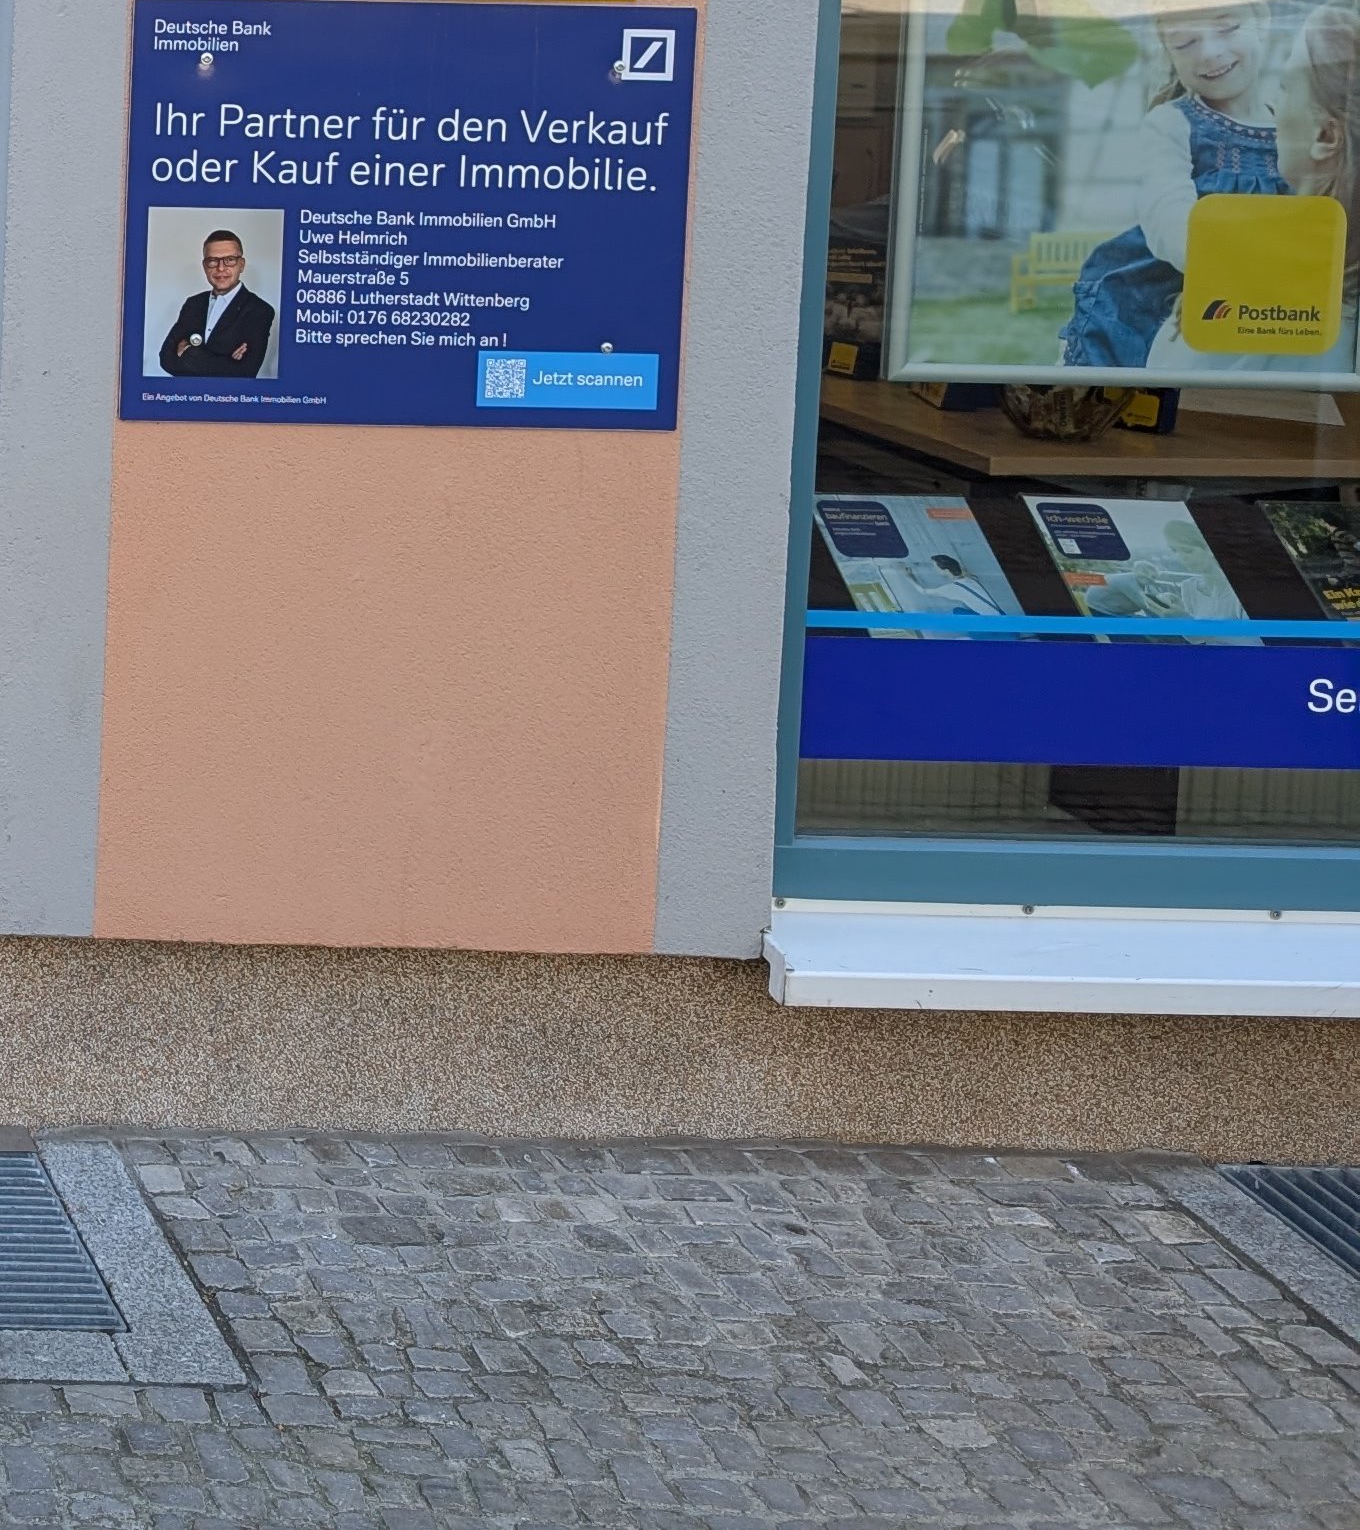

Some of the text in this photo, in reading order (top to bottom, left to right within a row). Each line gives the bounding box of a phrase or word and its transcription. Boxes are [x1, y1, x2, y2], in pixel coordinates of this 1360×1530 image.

[154, 19, 272, 36] Deutsche Bank
[154, 36, 239, 52] Immobilien
[155, 102, 669, 146] Ihr Partner für den Verkauf
[151, 149, 657, 191] oder Kauf einer Immobilie.
[300, 209, 557, 229] Deutsche Bank Immobilien GmbH
[299, 230, 408, 246] Uwe Helmrich
[298, 249, 565, 269] Selbstständiger Immobilienberater
[297, 269, 410, 286] Mauerstraße 5
[296, 289, 530, 311] 06886 Lutherstadt Wittenberg
[296, 309, 470, 327] Mobil: 0176 68230282
[1238, 304, 1320, 322] Postbank
[295, 329, 499, 349] Bitte sprechen Sie mich an
[1257, 327, 1275, 335] Bank
[1278, 327, 1294, 336] fürs
[1295, 328, 1322, 336] Leben.
[532, 371, 643, 387] Jetzt scannen
[142, 393, 154, 401] Ein
[155, 393, 187, 403] Angebot
[203, 394, 239, 403] Deutsche
[240, 394, 259, 403] Bank
[260, 395, 302, 404] Immobilien
[303, 396, 327, 404] GmbH
[825, 512, 888, 521] baufinanzieren
[1046, 514, 1109, 525] ich-wechsle
[1307, 678, 1360, 713] Se
